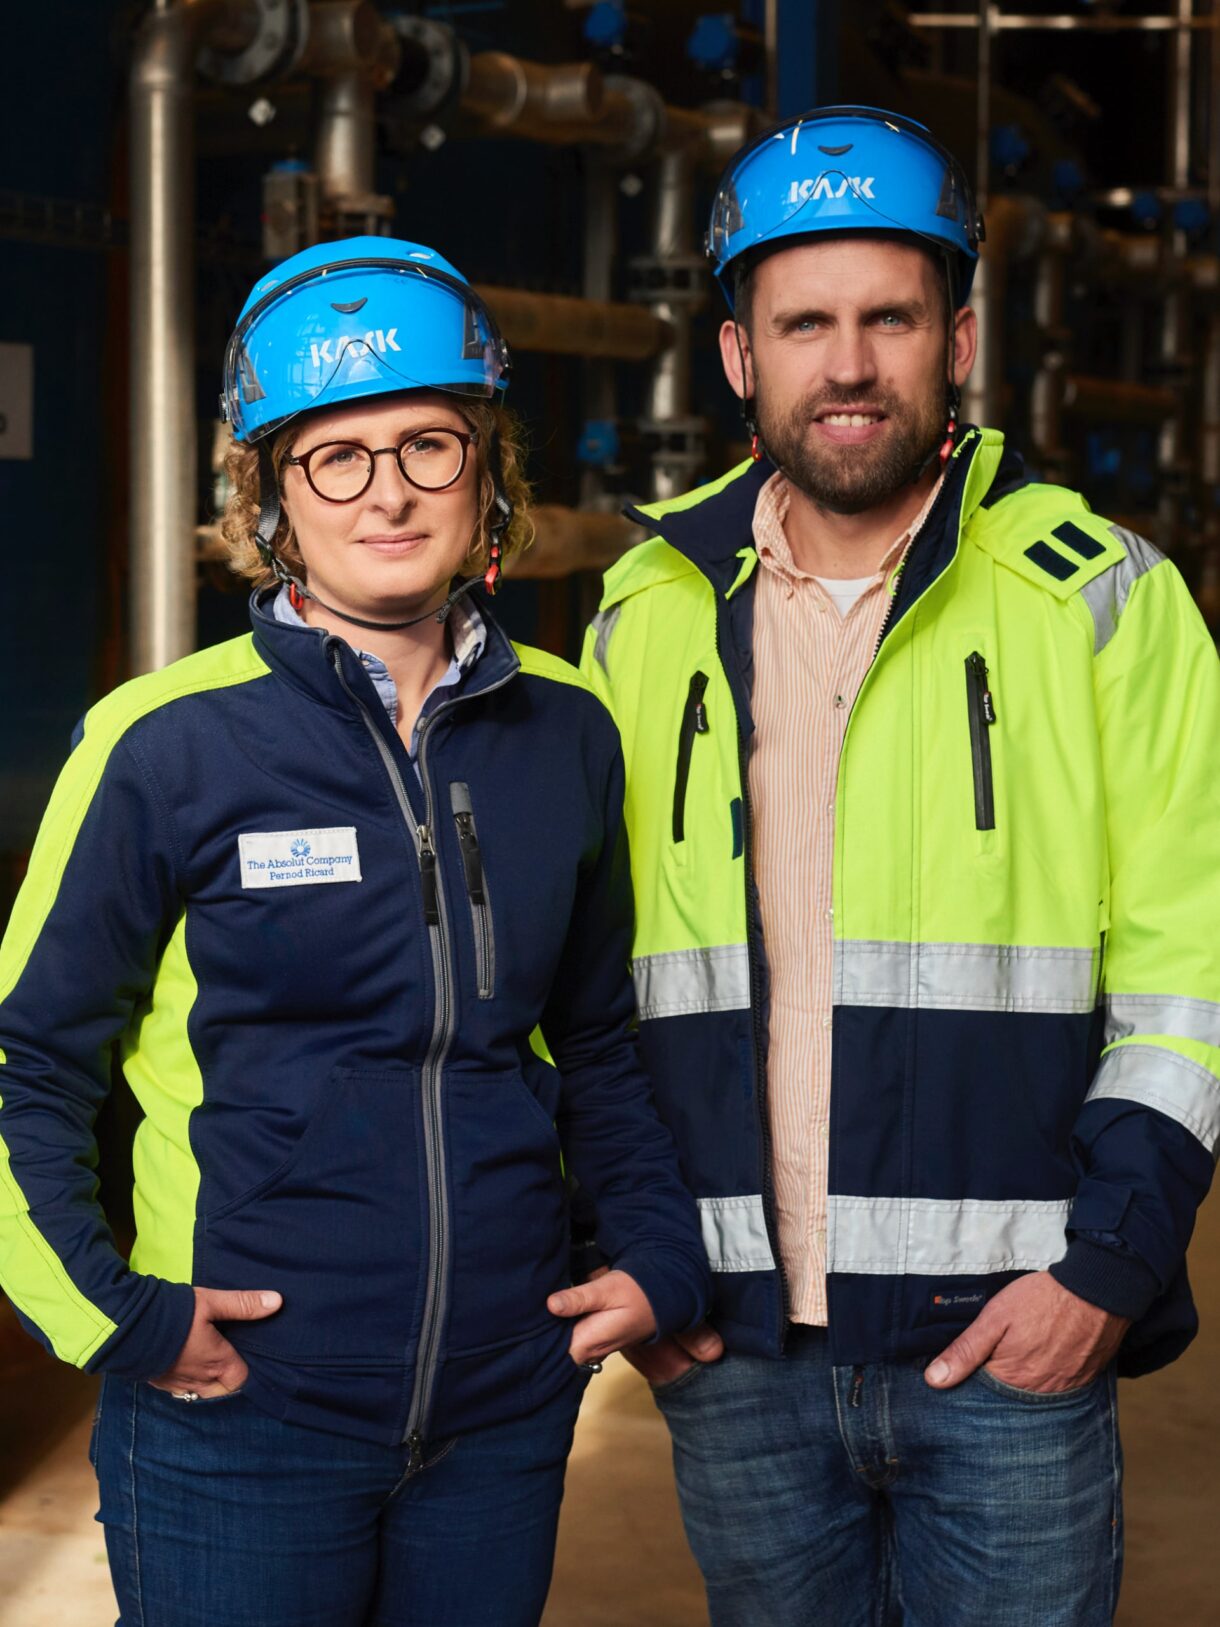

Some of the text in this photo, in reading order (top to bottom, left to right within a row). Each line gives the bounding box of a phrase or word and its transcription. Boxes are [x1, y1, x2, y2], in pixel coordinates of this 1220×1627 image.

[790, 176, 876, 203] KASK
[310, 328, 402, 368] KASK
[247, 855, 353, 870] The Absolut Company
[269, 867, 334, 880] Pernod Ricard
